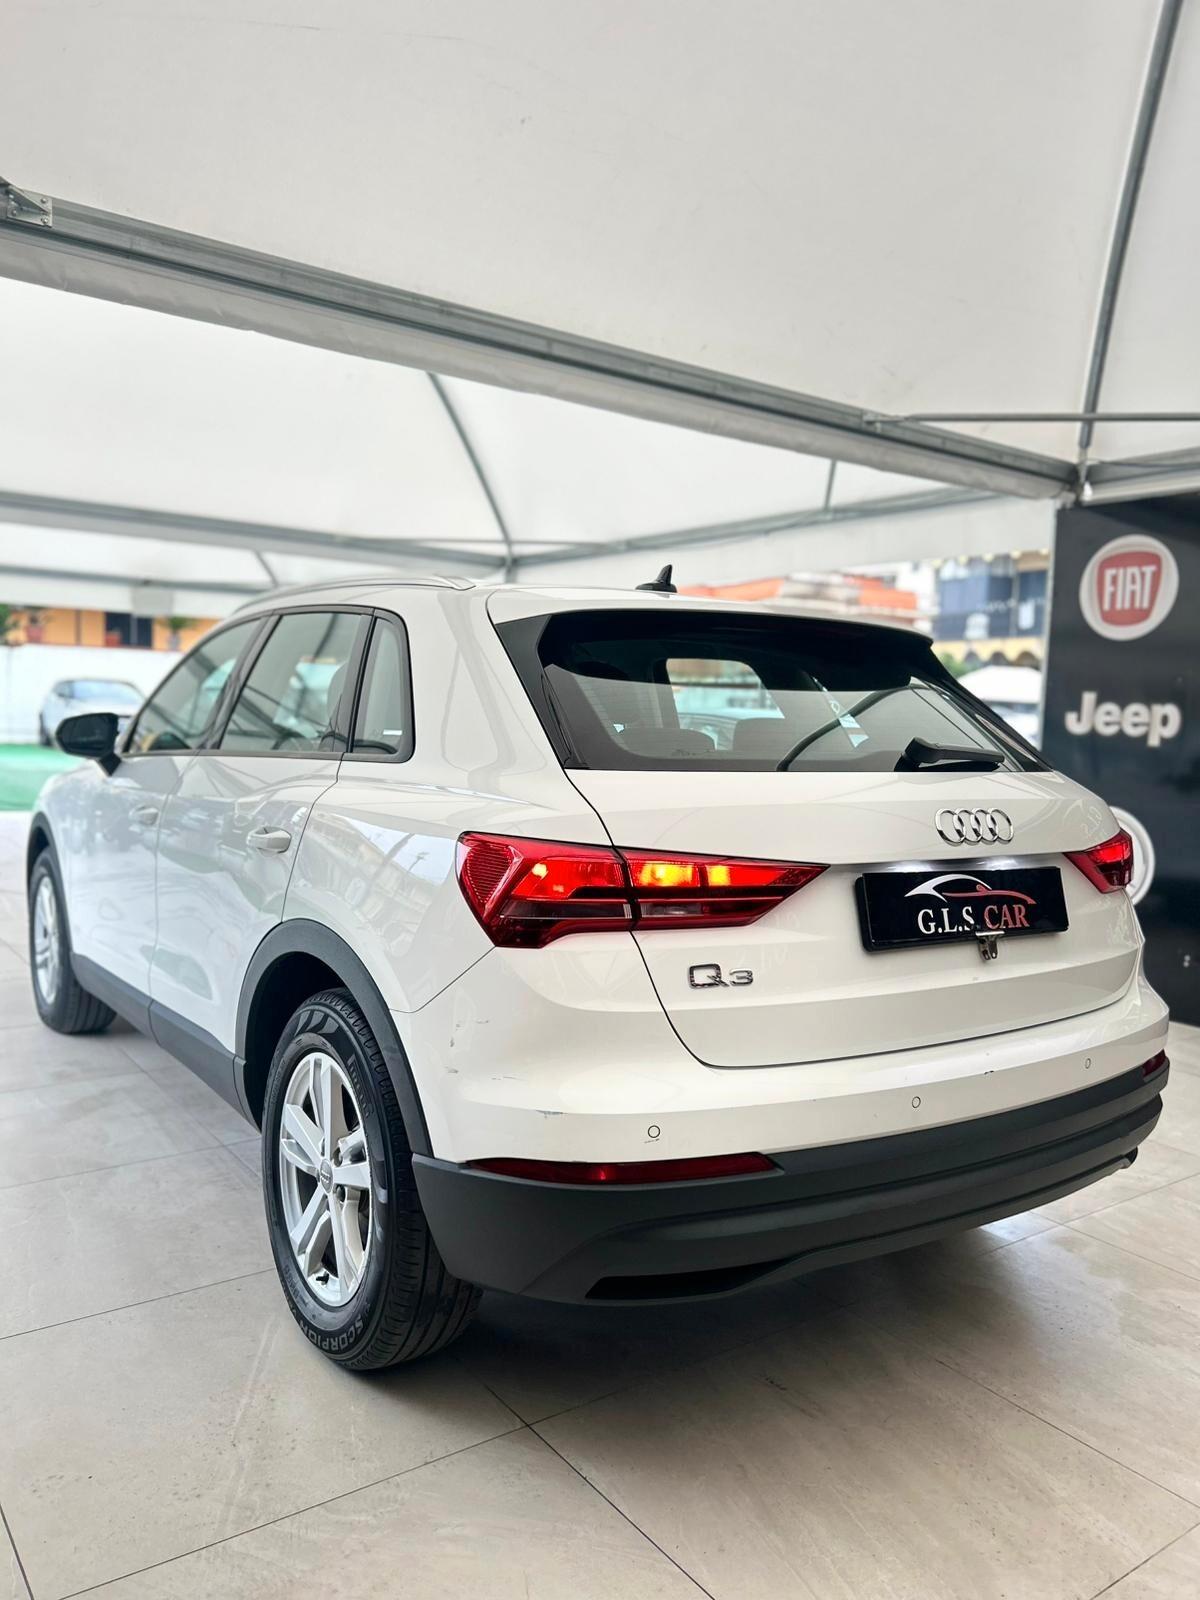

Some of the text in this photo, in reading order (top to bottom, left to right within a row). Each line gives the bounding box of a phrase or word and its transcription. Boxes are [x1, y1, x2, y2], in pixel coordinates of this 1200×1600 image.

[1102, 565, 1158, 612] FIAT
[1064, 690, 1182, 747] Jeep
[983, 904, 1030, 930] CAR
[689, 963, 753, 988] Q3
